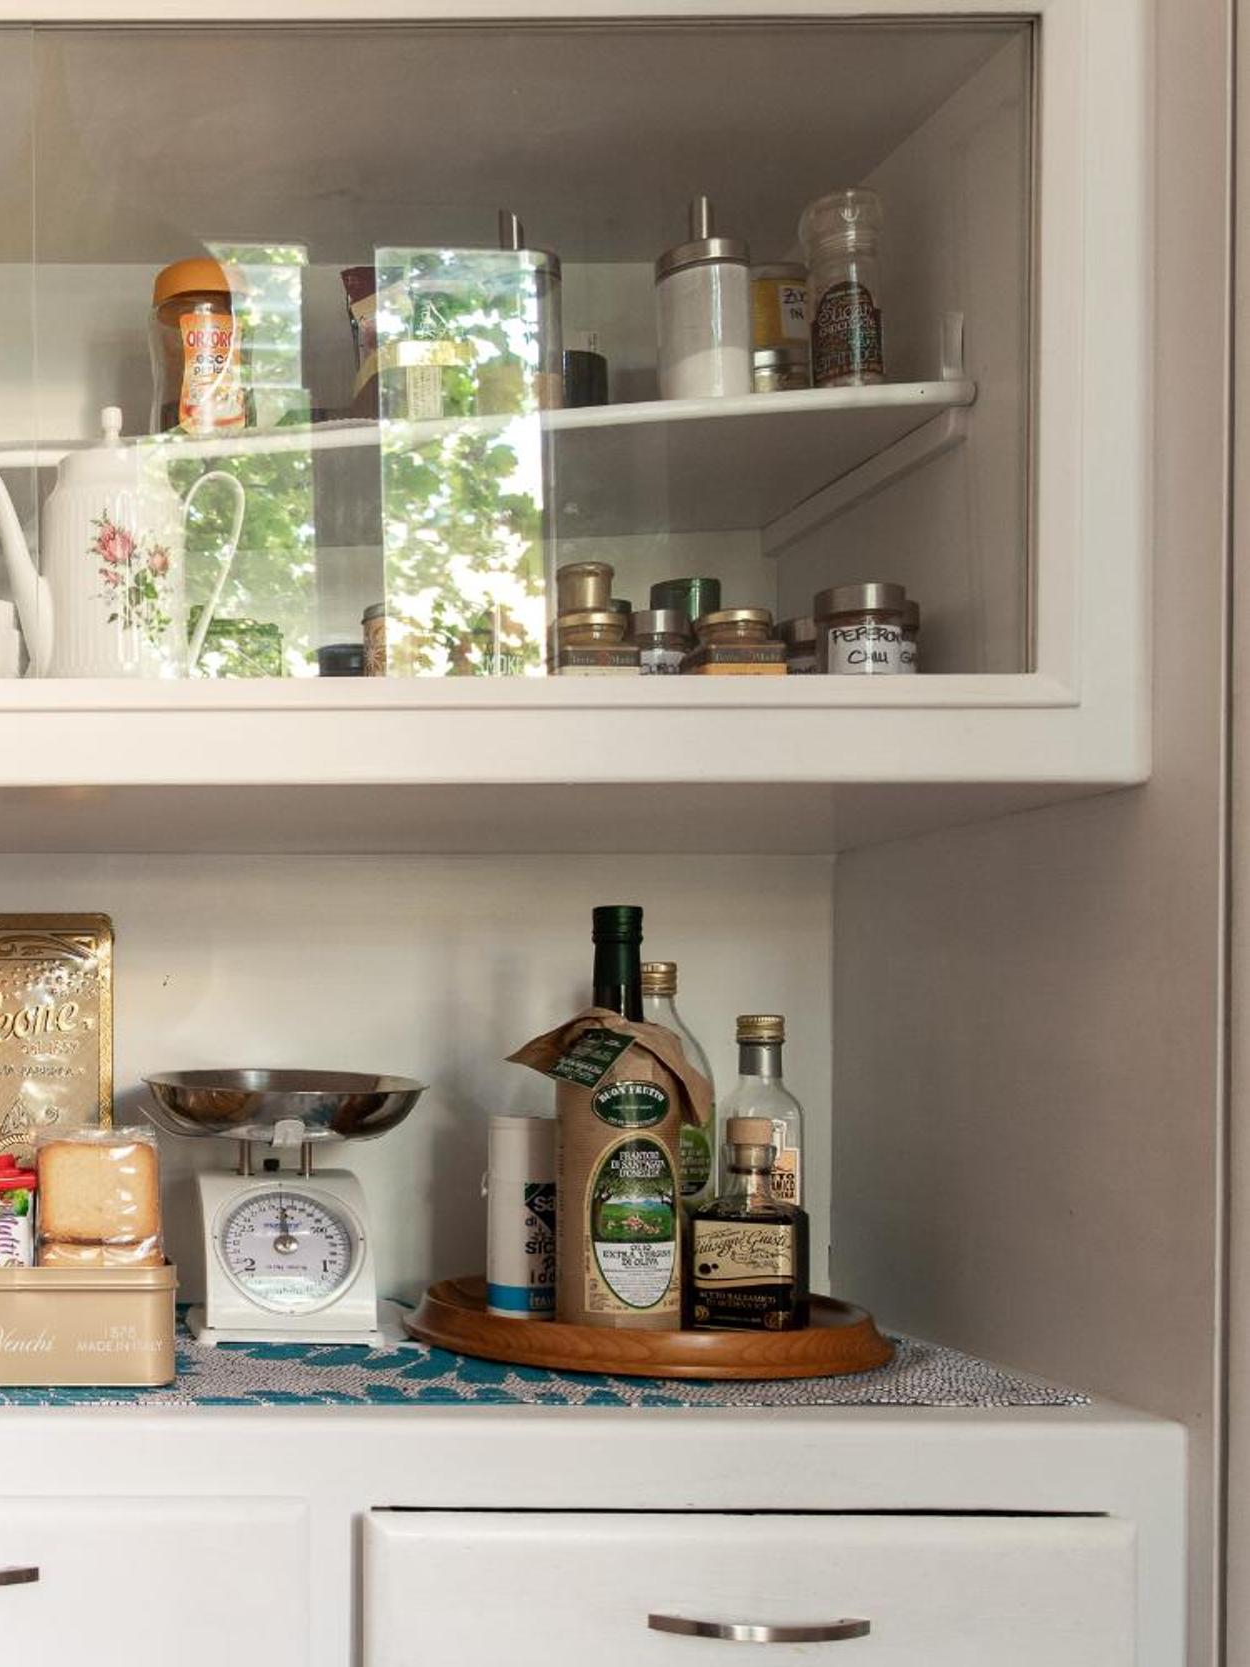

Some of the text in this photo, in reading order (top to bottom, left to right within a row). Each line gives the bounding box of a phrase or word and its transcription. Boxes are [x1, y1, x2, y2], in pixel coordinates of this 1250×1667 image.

[244, 1258, 256, 1272] 2
[322, 1259, 329, 1273] 1
[77, 1340, 112, 1352] MADE
